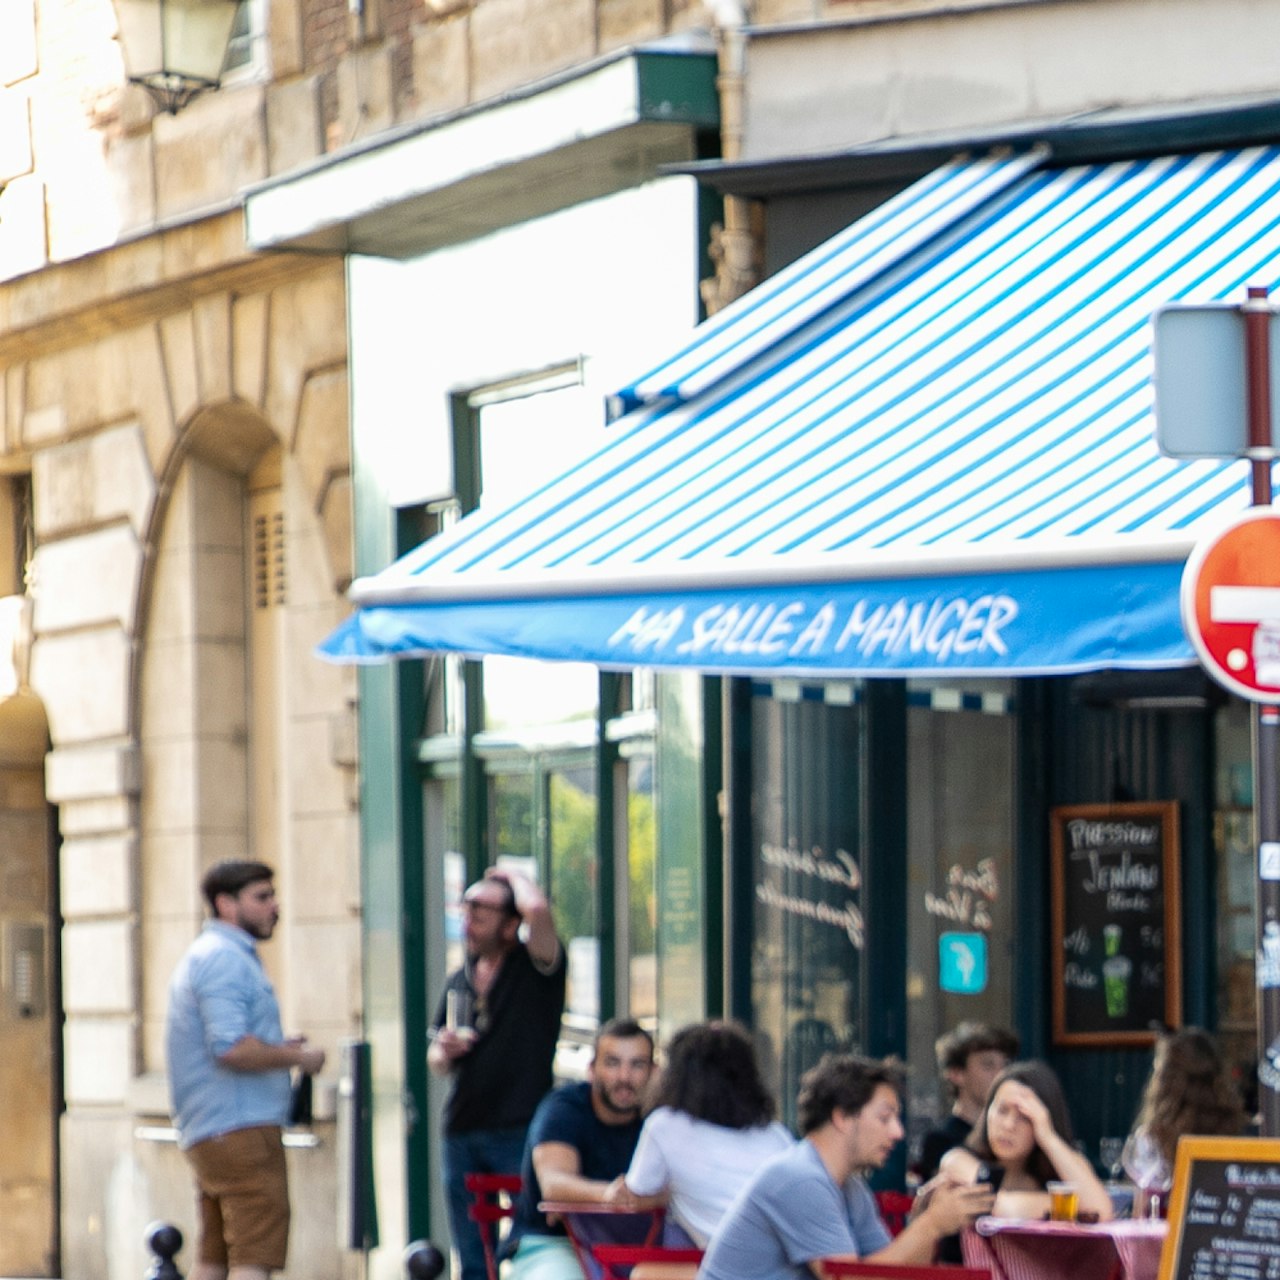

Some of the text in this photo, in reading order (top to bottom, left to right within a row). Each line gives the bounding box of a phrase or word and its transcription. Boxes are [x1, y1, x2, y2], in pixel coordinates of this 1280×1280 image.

[608, 605, 681, 649] MA
[683, 601, 802, 655] SALLE
[837, 593, 1018, 662] MANGER
